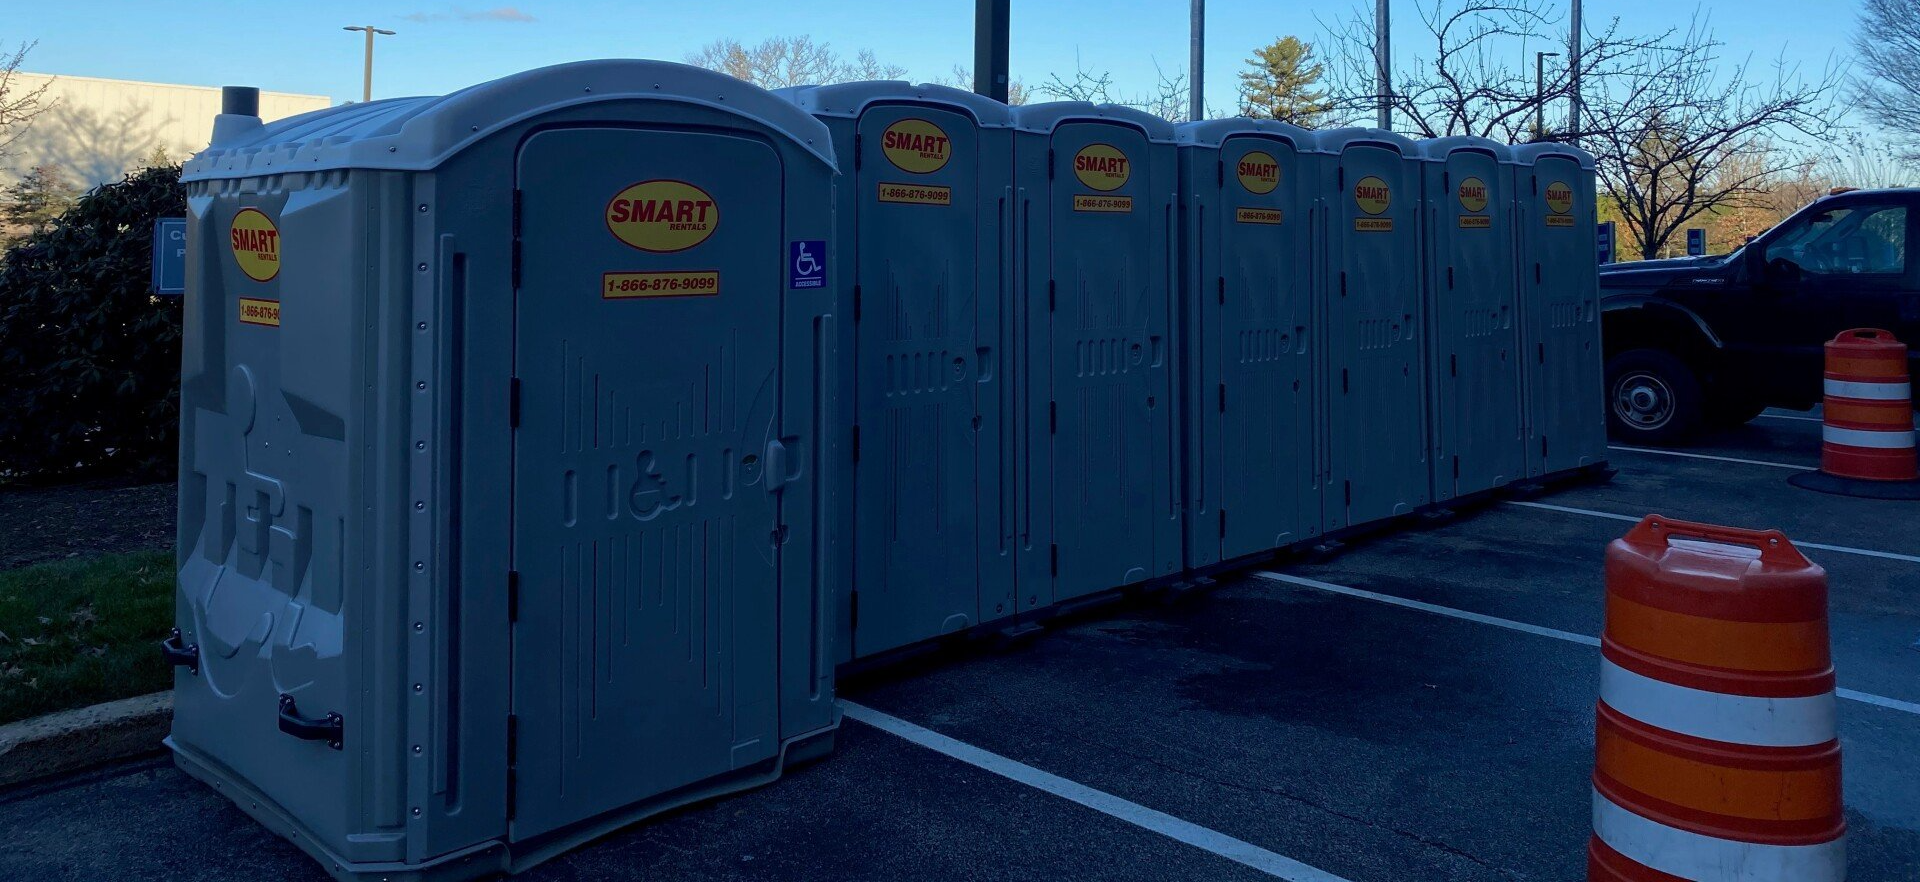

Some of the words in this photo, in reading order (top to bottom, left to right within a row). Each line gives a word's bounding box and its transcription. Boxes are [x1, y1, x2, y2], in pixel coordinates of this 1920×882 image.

[885, 130, 947, 154] SMART
[920, 152, 944, 160] RENTALS
[1076, 155, 1126, 173] SMART
[1239, 161, 1277, 177] SMART
[882, 187, 949, 201] 1-866-876-9099
[1357, 186, 1388, 199] SMART
[1460, 186, 1486, 198] SMART
[1547, 189, 1572, 201] SMART
[1076, 199, 1130, 208] 1-866-876-9099
[611, 198, 712, 223] SMART
[670, 223, 707, 231] RENTALS
[231, 227, 277, 253] SMART
[257, 253, 278, 261] RENTALS
[608, 277, 715, 292] 1-866-876-9099
